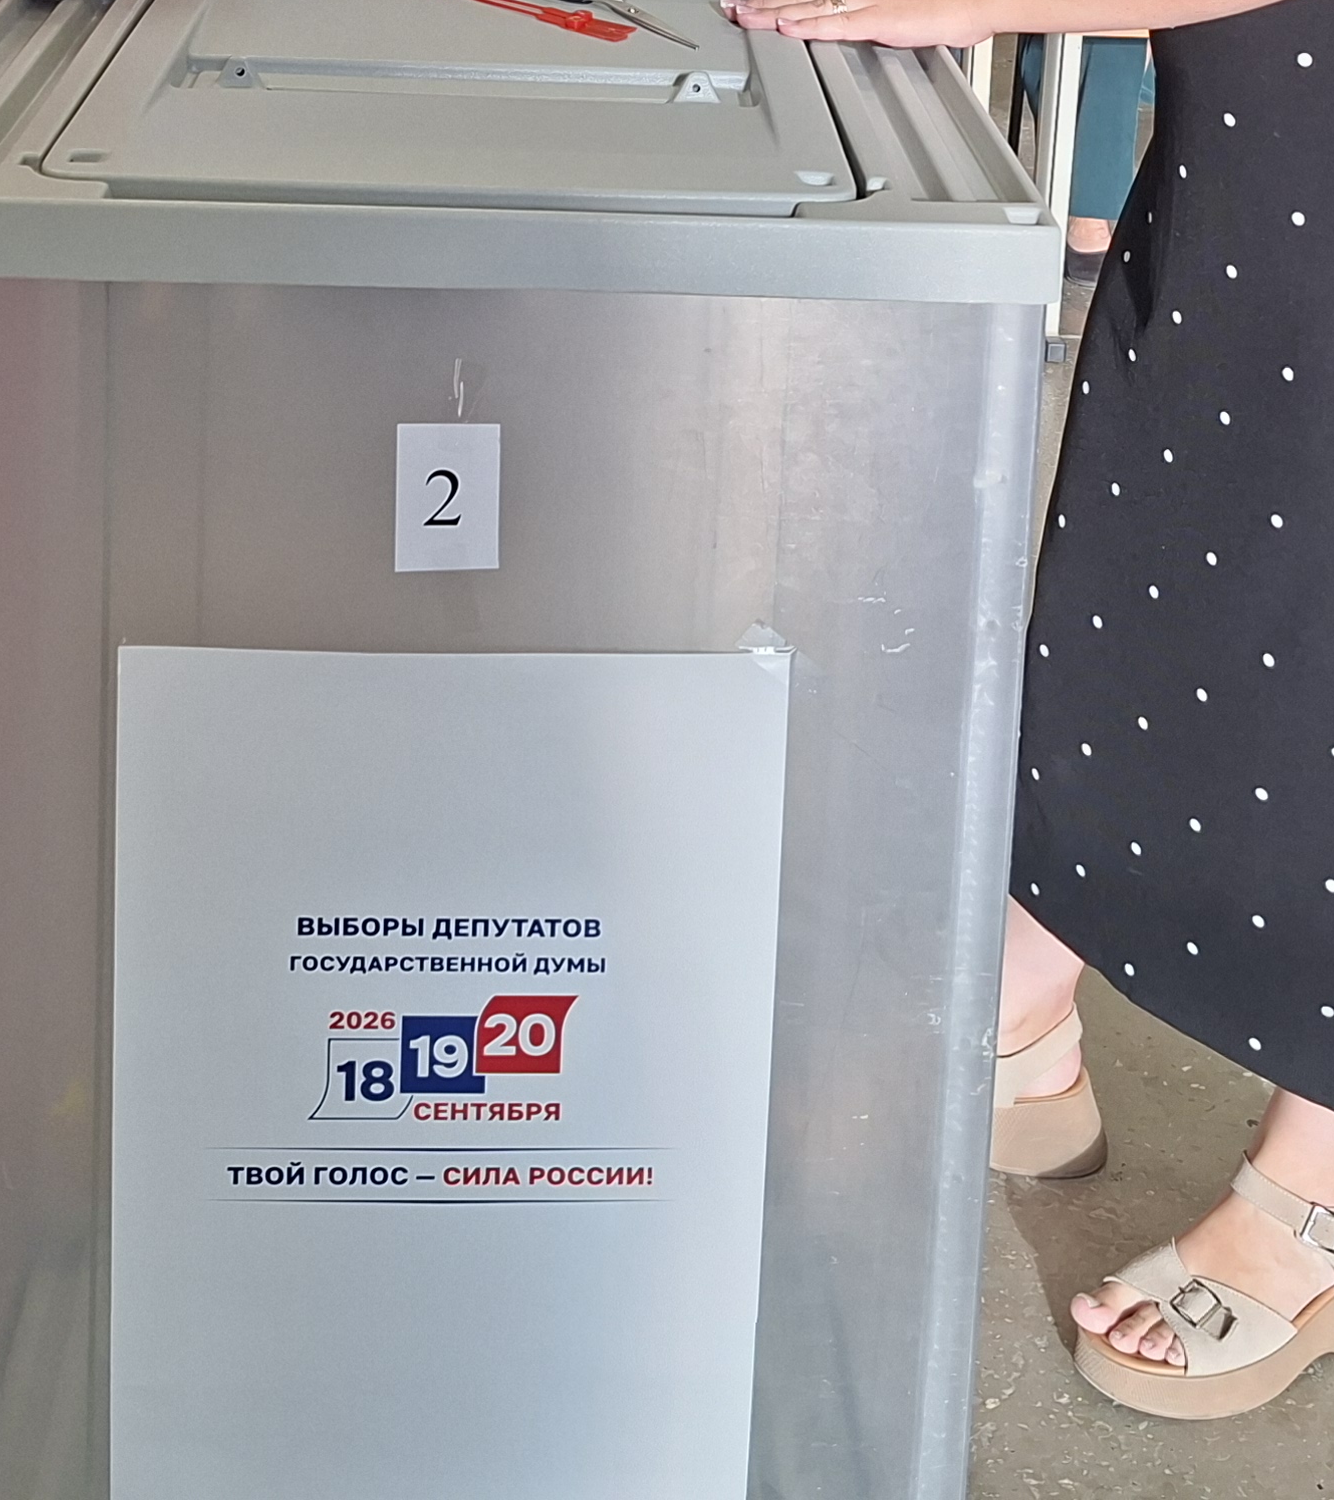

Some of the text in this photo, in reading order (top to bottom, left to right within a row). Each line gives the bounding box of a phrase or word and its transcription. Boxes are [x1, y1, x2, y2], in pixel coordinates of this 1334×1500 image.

[423, 469, 462, 526] 2
[296, 917, 602, 940] ВЫБОРЫ ДЕПУТАТОВ
[289, 953, 606, 975] ГОСУДАРСТВЕННОЙ ДУМЫ
[328, 1011, 396, 1030] 2026
[336, 1013, 556, 1102] 18 19 20
[413, 1102, 562, 1122] СЕНТЯБРЯ
[227, 1161, 305, 1185] ТВОЙ
[313, 1166, 408, 1185] ГОЛОС
[442, 1167, 520, 1185] СИЛА
[529, 1167, 653, 1185] РОССИИ!
